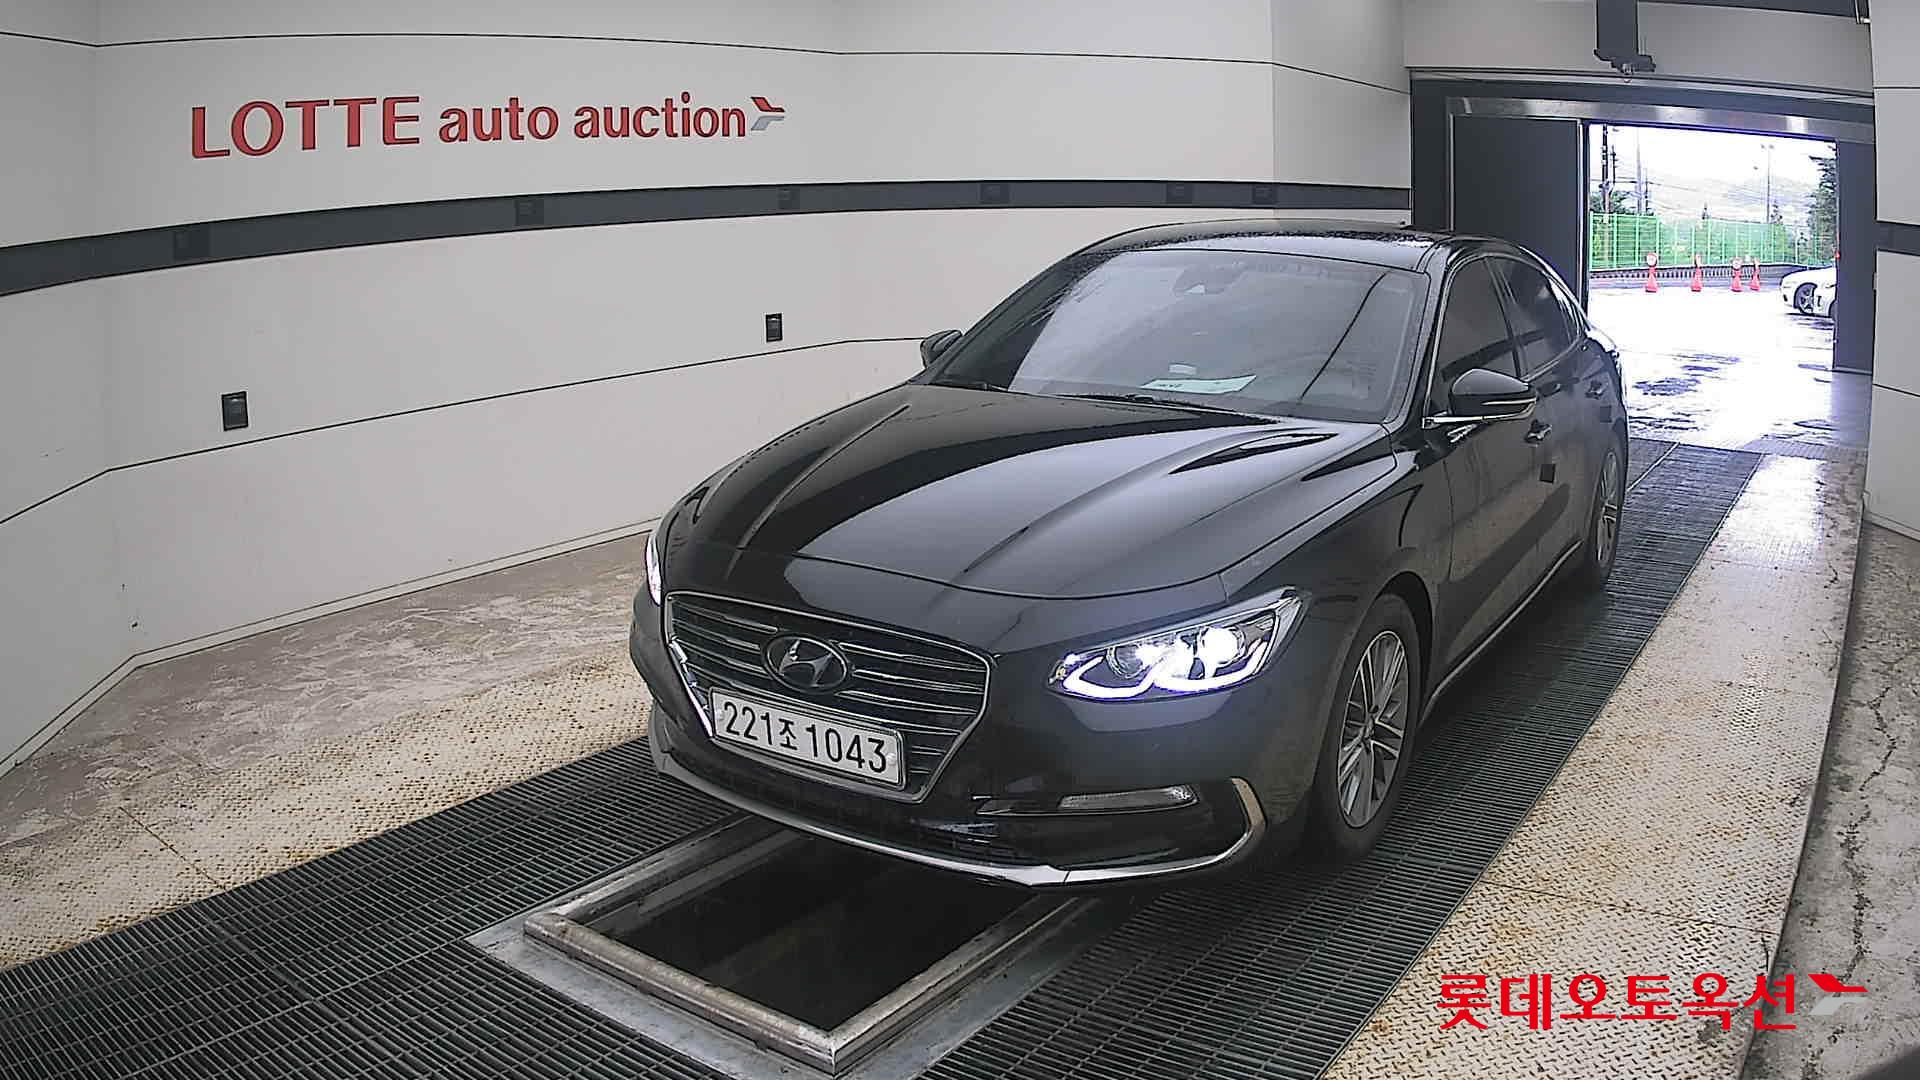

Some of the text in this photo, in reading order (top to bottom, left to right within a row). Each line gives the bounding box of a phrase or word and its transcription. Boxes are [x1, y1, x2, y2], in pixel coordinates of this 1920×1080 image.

[191, 91, 747, 159] LOTTE auto auction
[723, 701, 887, 774] 221조 1043
